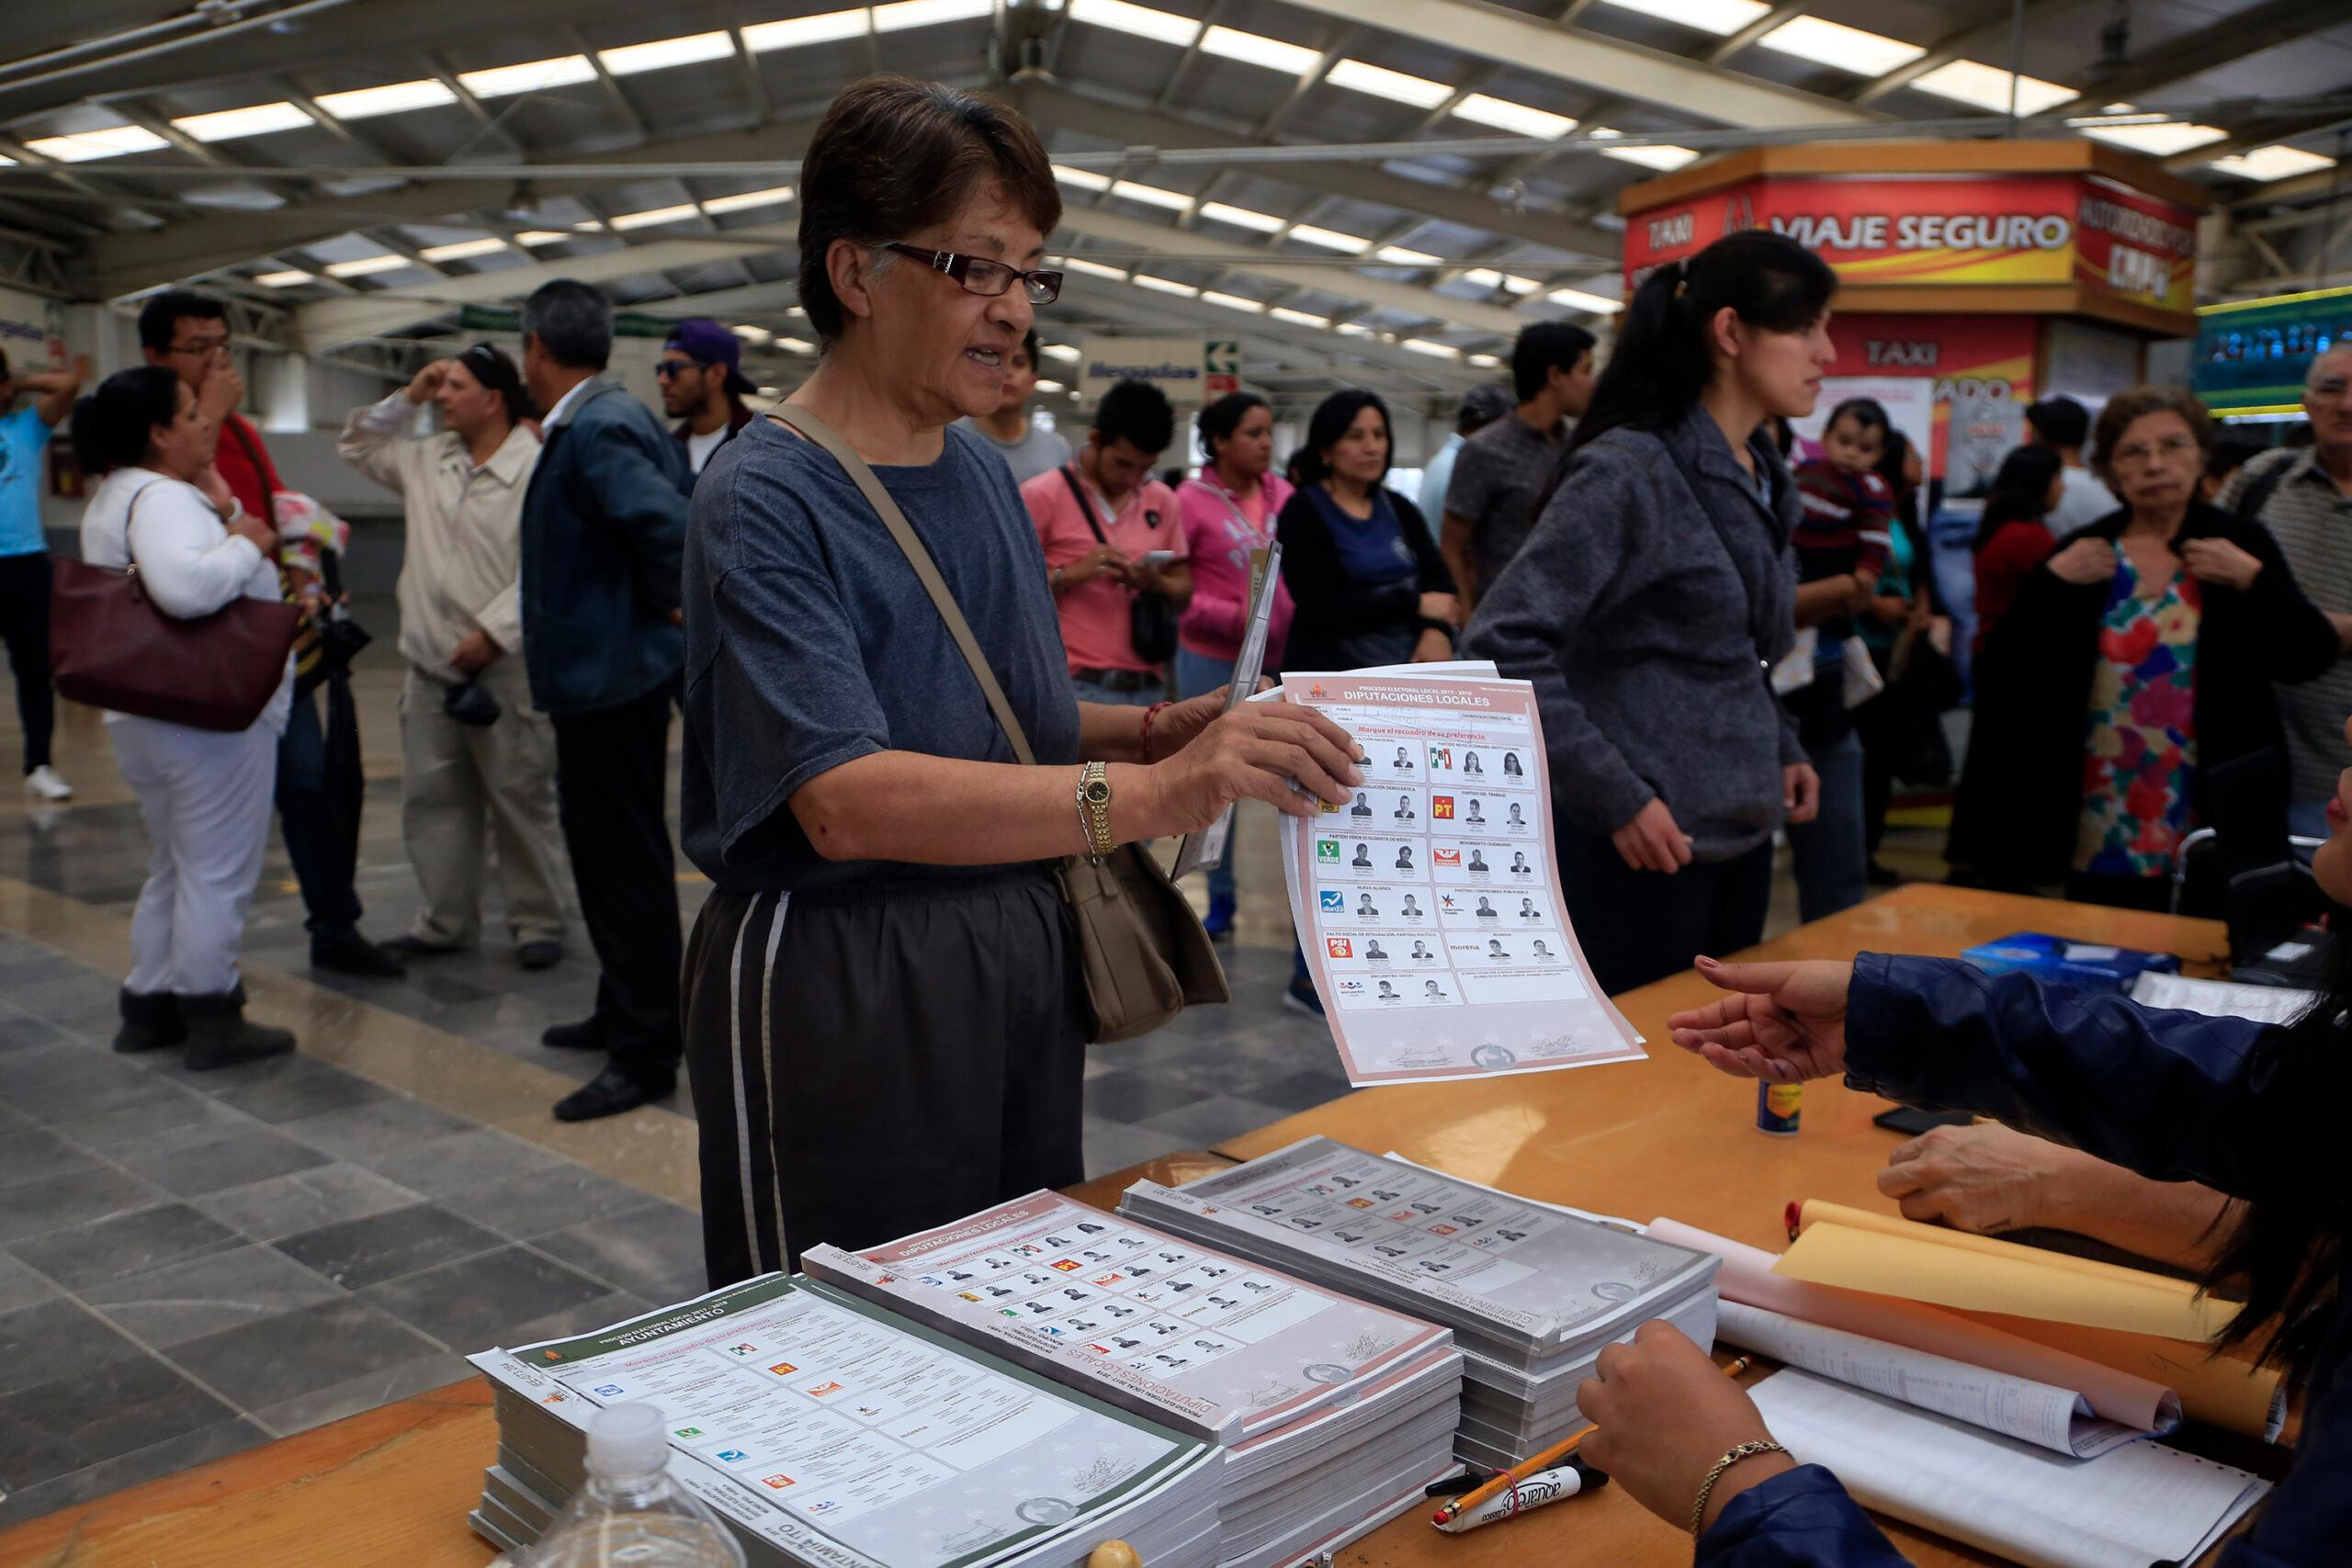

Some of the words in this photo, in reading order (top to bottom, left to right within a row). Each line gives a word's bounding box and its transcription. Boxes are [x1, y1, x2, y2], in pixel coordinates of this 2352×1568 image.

[1649, 211, 1692, 249] TAXI
[1771, 216, 1887, 249] VIAJE
[1896, 215, 2071, 250] SEGURO
[1866, 340, 1938, 365] TAXI
[1344, 691, 1434, 705] DIPUTACIONES
[1436, 694, 1490, 707] LOCALES
[1358, 726, 1386, 736] Marque
[1395, 728, 1426, 737] recuadro
[1445, 731, 1486, 741] preferencia
[1430, 748, 1453, 770] PRI
[1434, 803, 1453, 818] PT
[1330, 939, 1348, 947] PSI
[899, 1228, 980, 1258] DIPUTACIONES
[981, 1210, 1030, 1236] LOCALES
[1434, 1283, 1533, 1325] GUBERNATURA
[598, 1333, 632, 1345] PROCESO
[631, 1320, 671, 1336] ELECTORAL
[670, 1314, 690, 1324] LOCAL
[712, 1300, 729, 1310] 2018
[618, 1308, 725, 1346] AYUNTAMIENTO
[625, 1354, 658, 1368] Marque
[725, 1317, 771, 1338] preferencia
[1065, 1347, 1122, 1375] LOCALES
[1095, 1370, 1111, 1378] 2018
[1111, 1376, 1127, 1385] 2017
[1116, 1368, 1213, 1414] DIPUTACIONES
[1125, 1382, 1145, 1393] LOCAL
[1143, 1391, 1176, 1406] ELECTORAL
[1174, 1404, 1203, 1417] PROCESO
